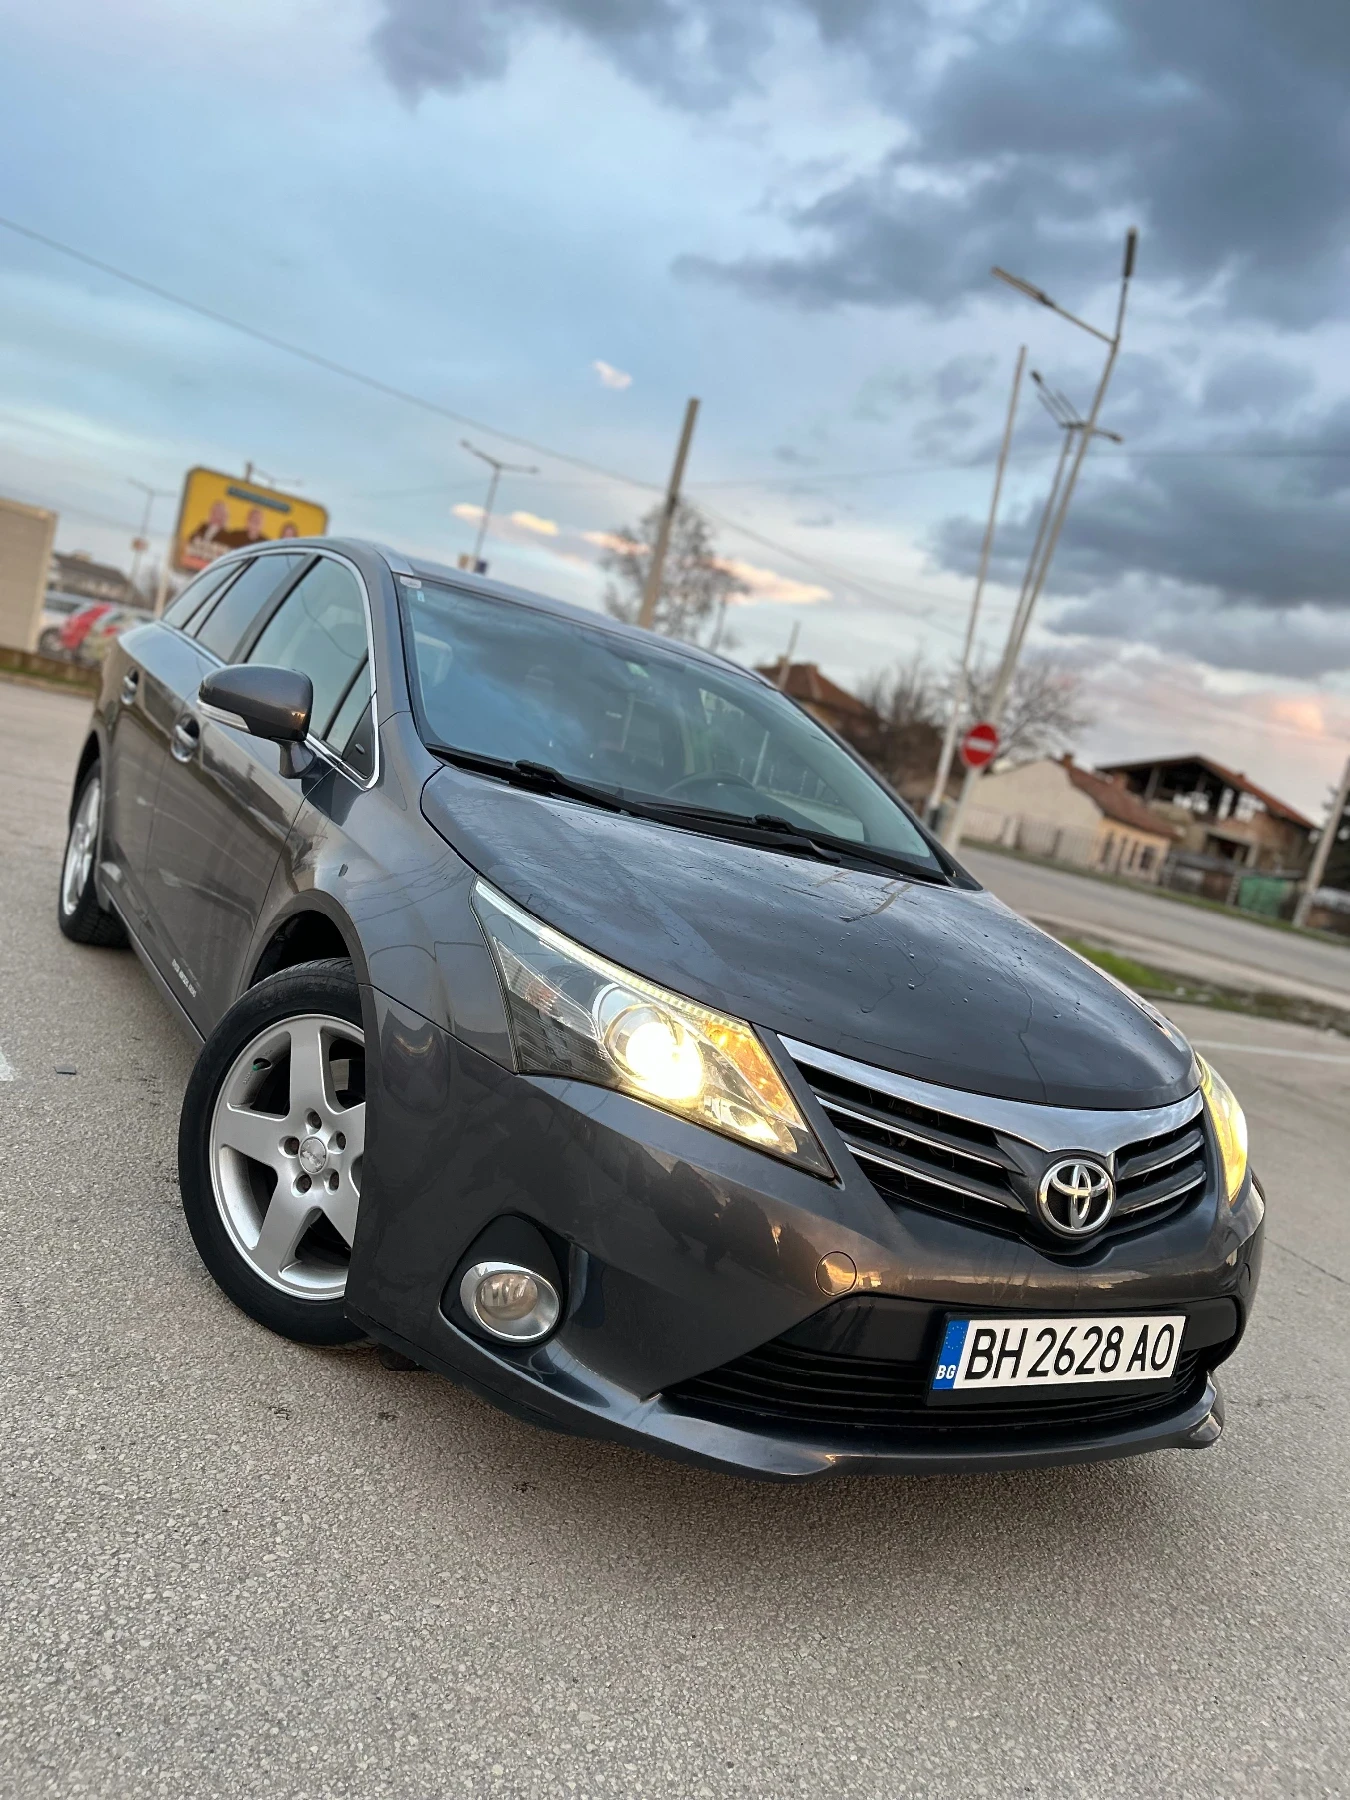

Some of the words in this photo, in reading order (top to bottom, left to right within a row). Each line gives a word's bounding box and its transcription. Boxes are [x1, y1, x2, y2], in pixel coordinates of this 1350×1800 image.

[964, 1327, 1029, 1380] BH
[1027, 1325, 1125, 1378] 2628
[935, 1364, 957, 1380] BG
